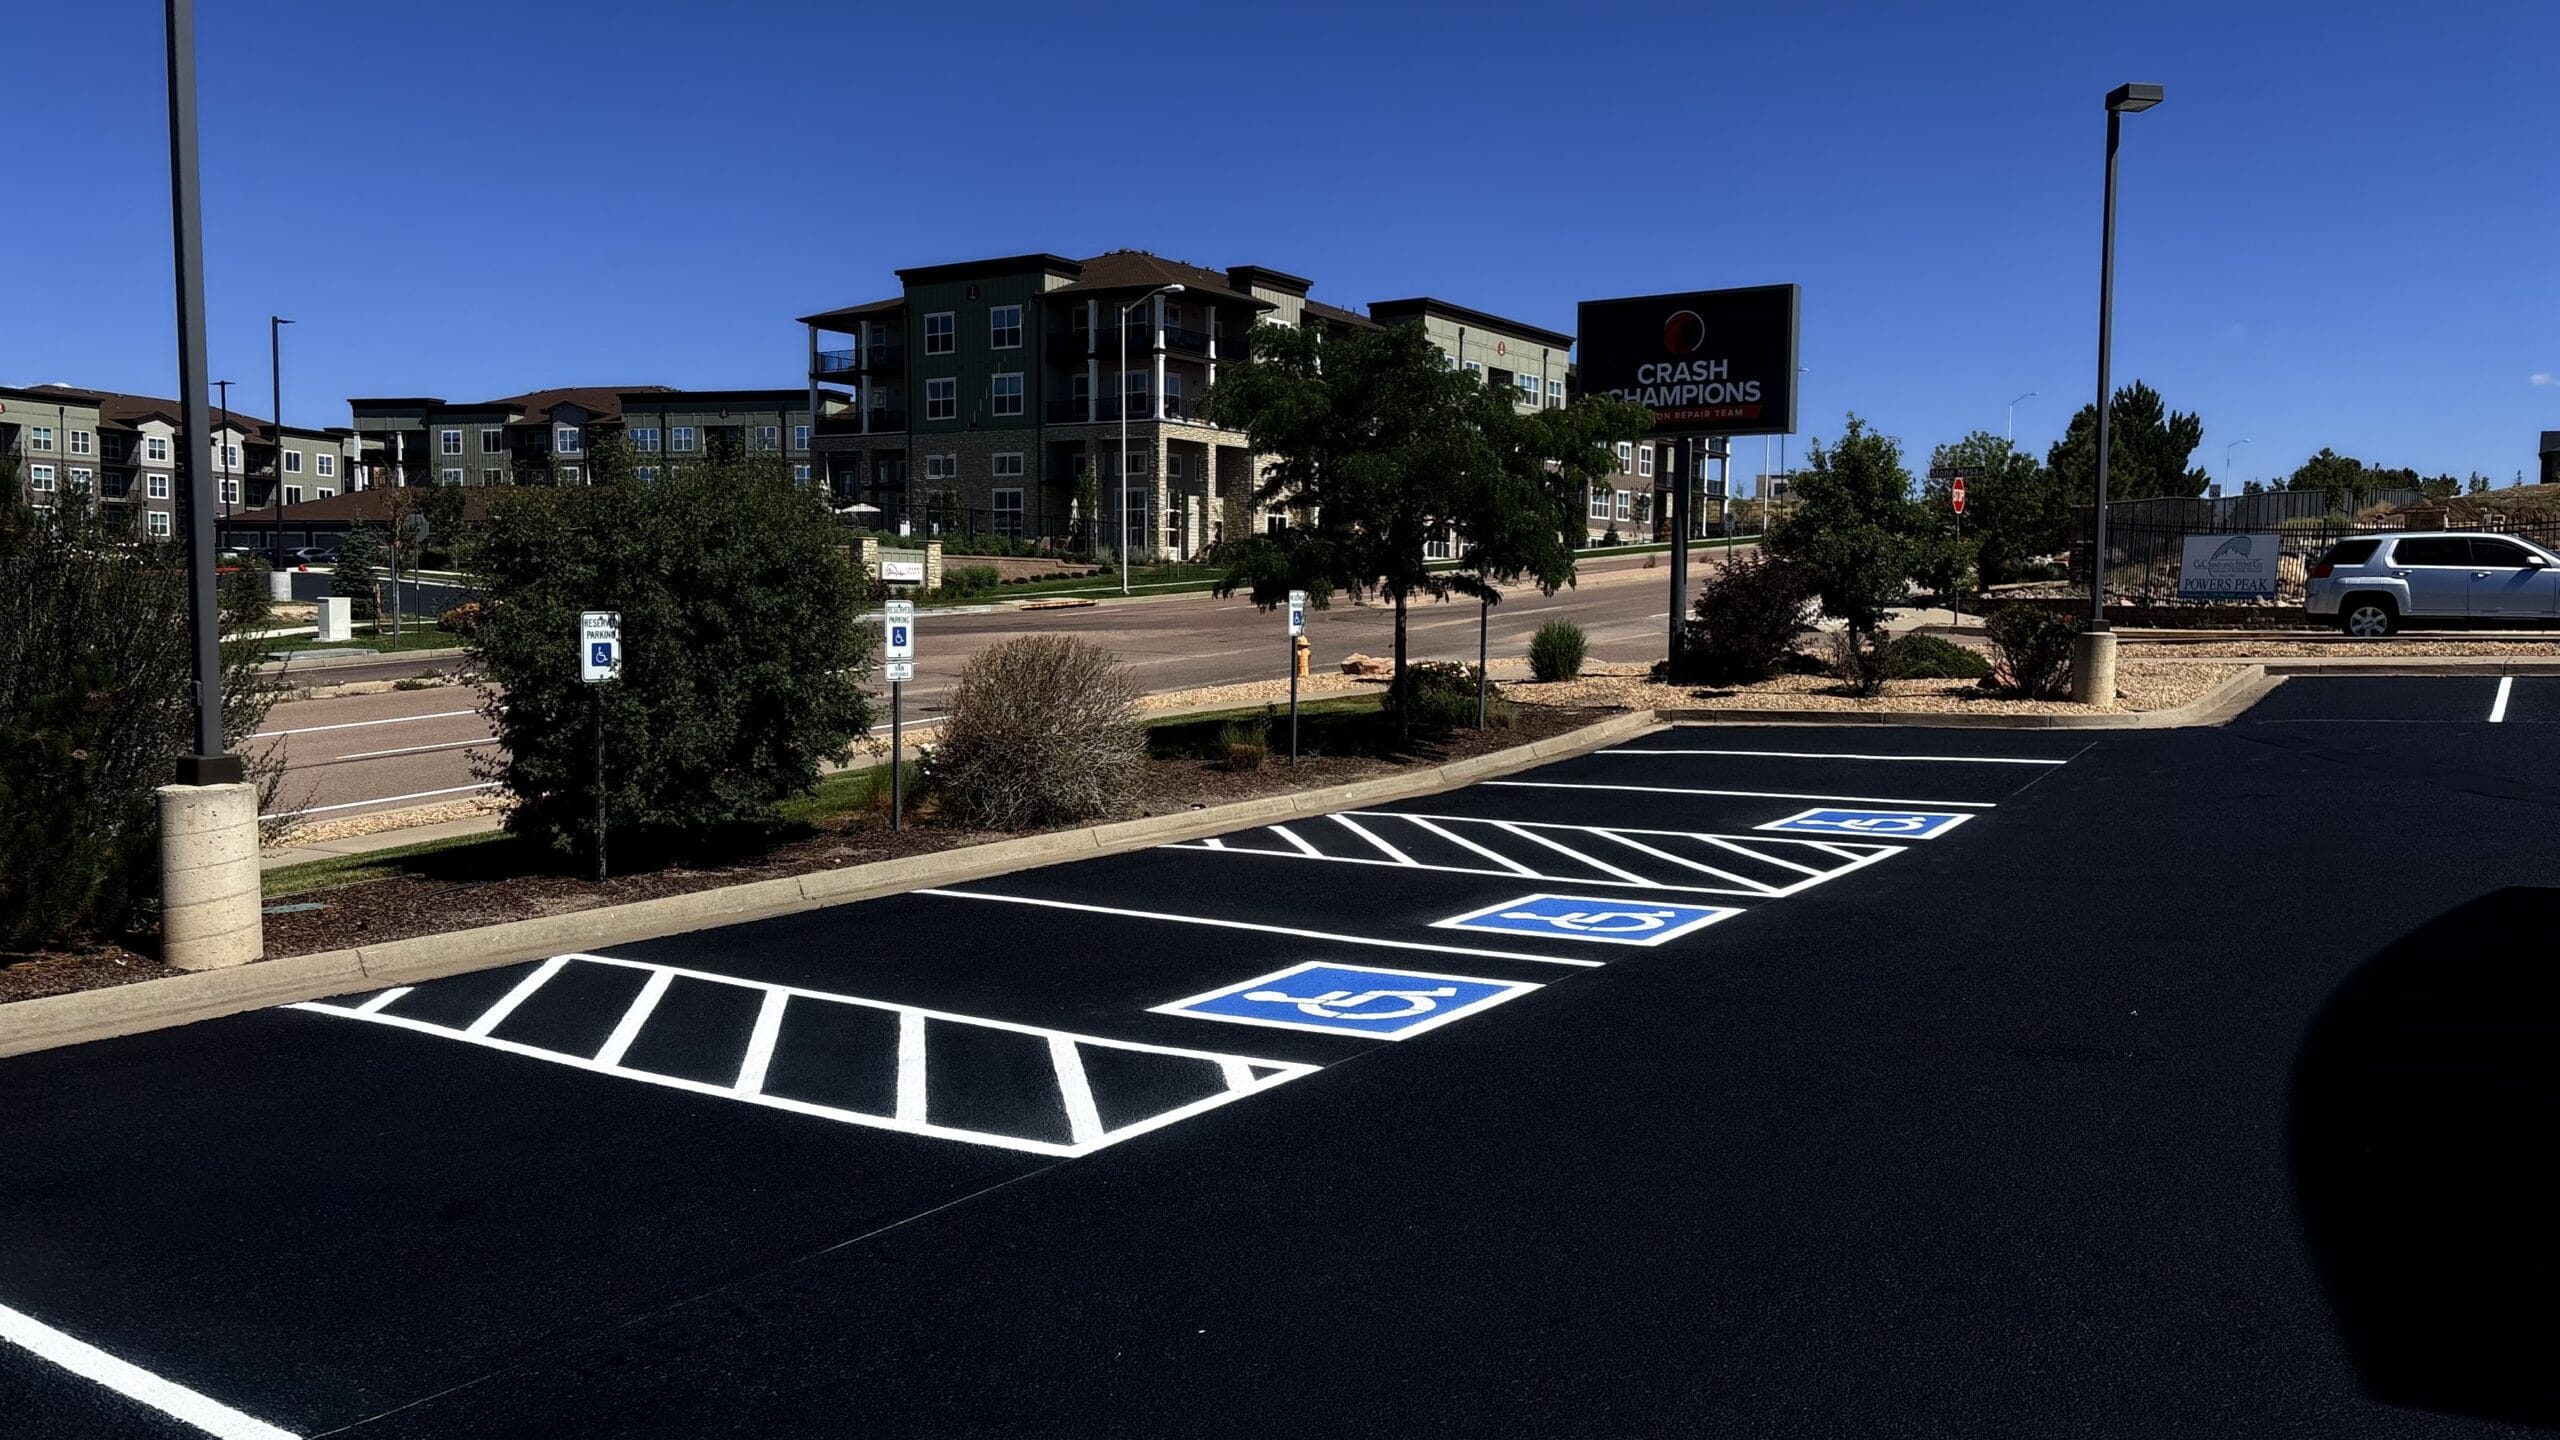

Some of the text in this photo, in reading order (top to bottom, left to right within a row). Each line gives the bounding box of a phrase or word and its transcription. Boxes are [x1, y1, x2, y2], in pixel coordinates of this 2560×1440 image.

[1637, 358, 1728, 385] CRASH
[1675, 410, 1710, 421] REPAIR
[1715, 408, 1744, 418] TEAM
[1952, 489, 1965, 502] STOP
[2185, 578, 2268, 591] POWERS PEAK
[887, 606, 912, 614] RESERVED
[584, 619, 618, 628] RESERV
[888, 616, 910, 624] PARKING
